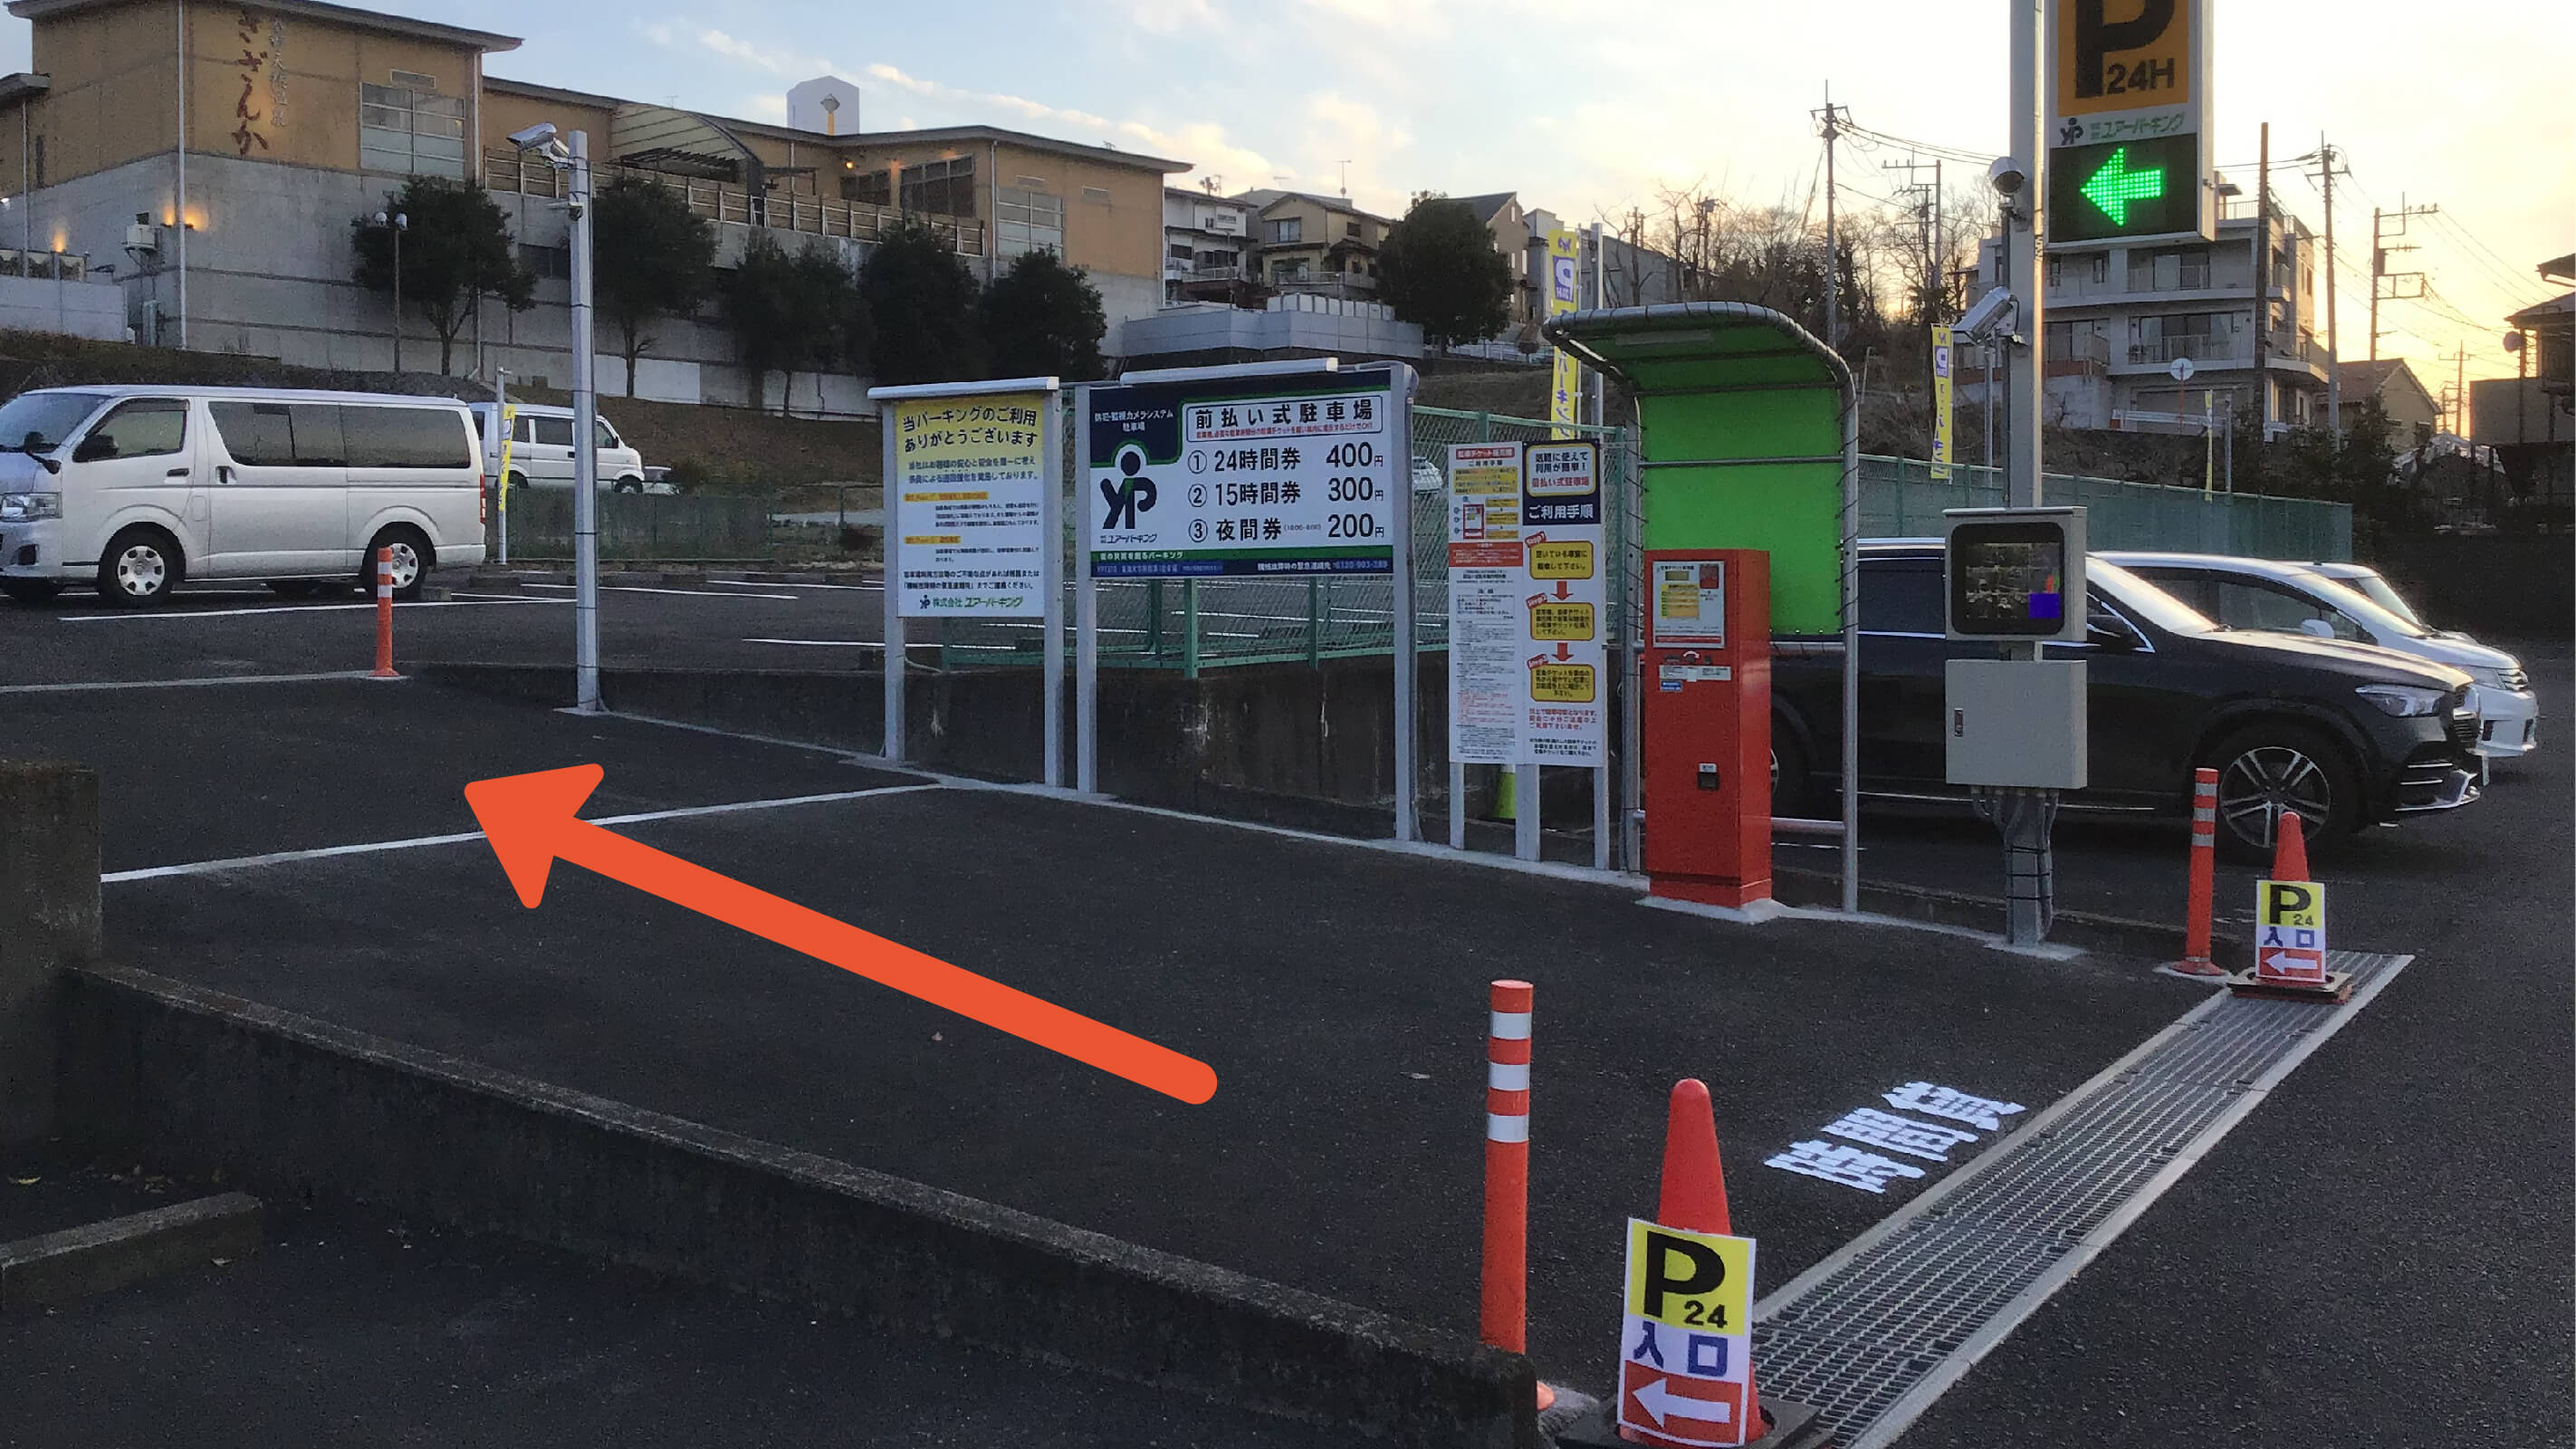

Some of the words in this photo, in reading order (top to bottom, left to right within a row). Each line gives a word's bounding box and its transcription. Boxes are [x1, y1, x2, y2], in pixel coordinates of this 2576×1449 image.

[2106, 57, 2176, 96] 24H
[903, 406, 1037, 433] 当パーキングのご利用
[1122, 421, 1145, 432] 駐車場
[1195, 399, 1373, 429] 前払い式駐車場
[905, 427, 1038, 453] ありがとうございます
[1214, 447, 1301, 473] 24時間券
[1326, 442, 1384, 468] 400円
[1215, 481, 1301, 506] 15時間券
[1327, 477, 1384, 503] 300円
[1528, 504, 1594, 520] ご利用手順
[1216, 518, 1282, 542] 夜間券
[1327, 513, 1384, 538] 200円
[2269, 884, 2311, 926] P
[2293, 914, 2314, 926] 24
[2264, 926, 2315, 948] 入口
[1643, 1231, 1726, 1319] P
[1684, 1300, 1728, 1329] 24
[1633, 1320, 1729, 1377] 入口
